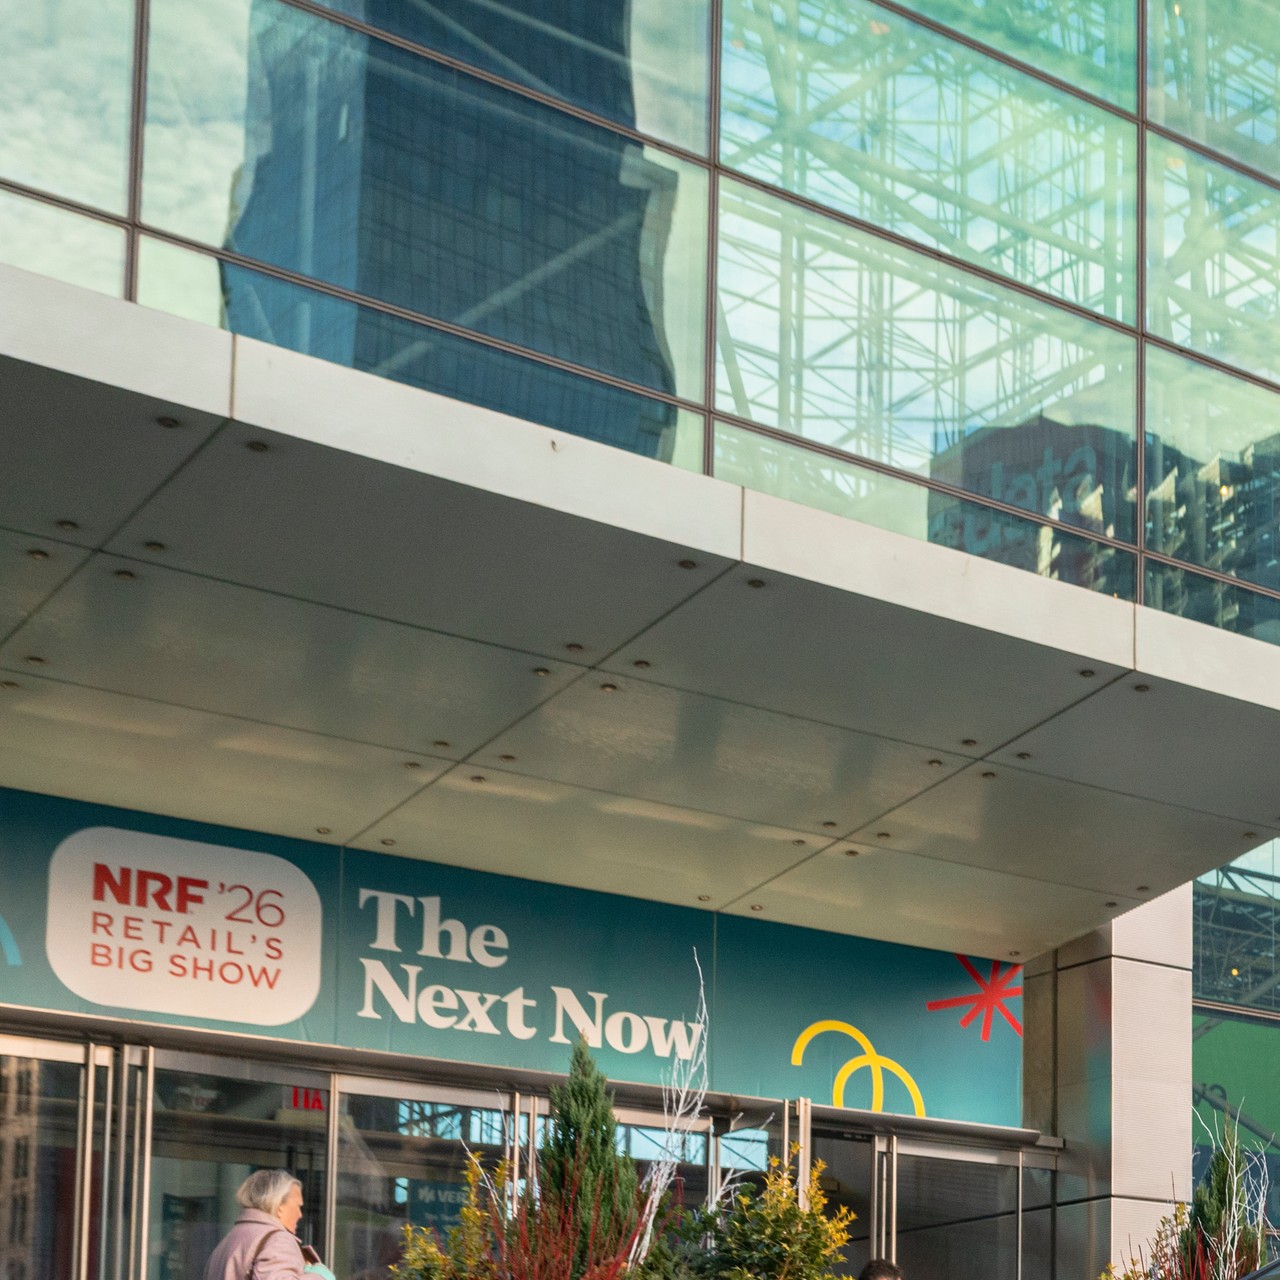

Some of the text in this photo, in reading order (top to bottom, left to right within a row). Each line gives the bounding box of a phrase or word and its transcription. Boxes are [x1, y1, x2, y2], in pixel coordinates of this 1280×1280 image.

[93, 862, 209, 914] NRF
[92, 911, 283, 960] RETAIL'S
[358, 888, 510, 968] The
[91, 942, 281, 990] BIG SHOW
[356, 957, 705, 1060] Next Now
